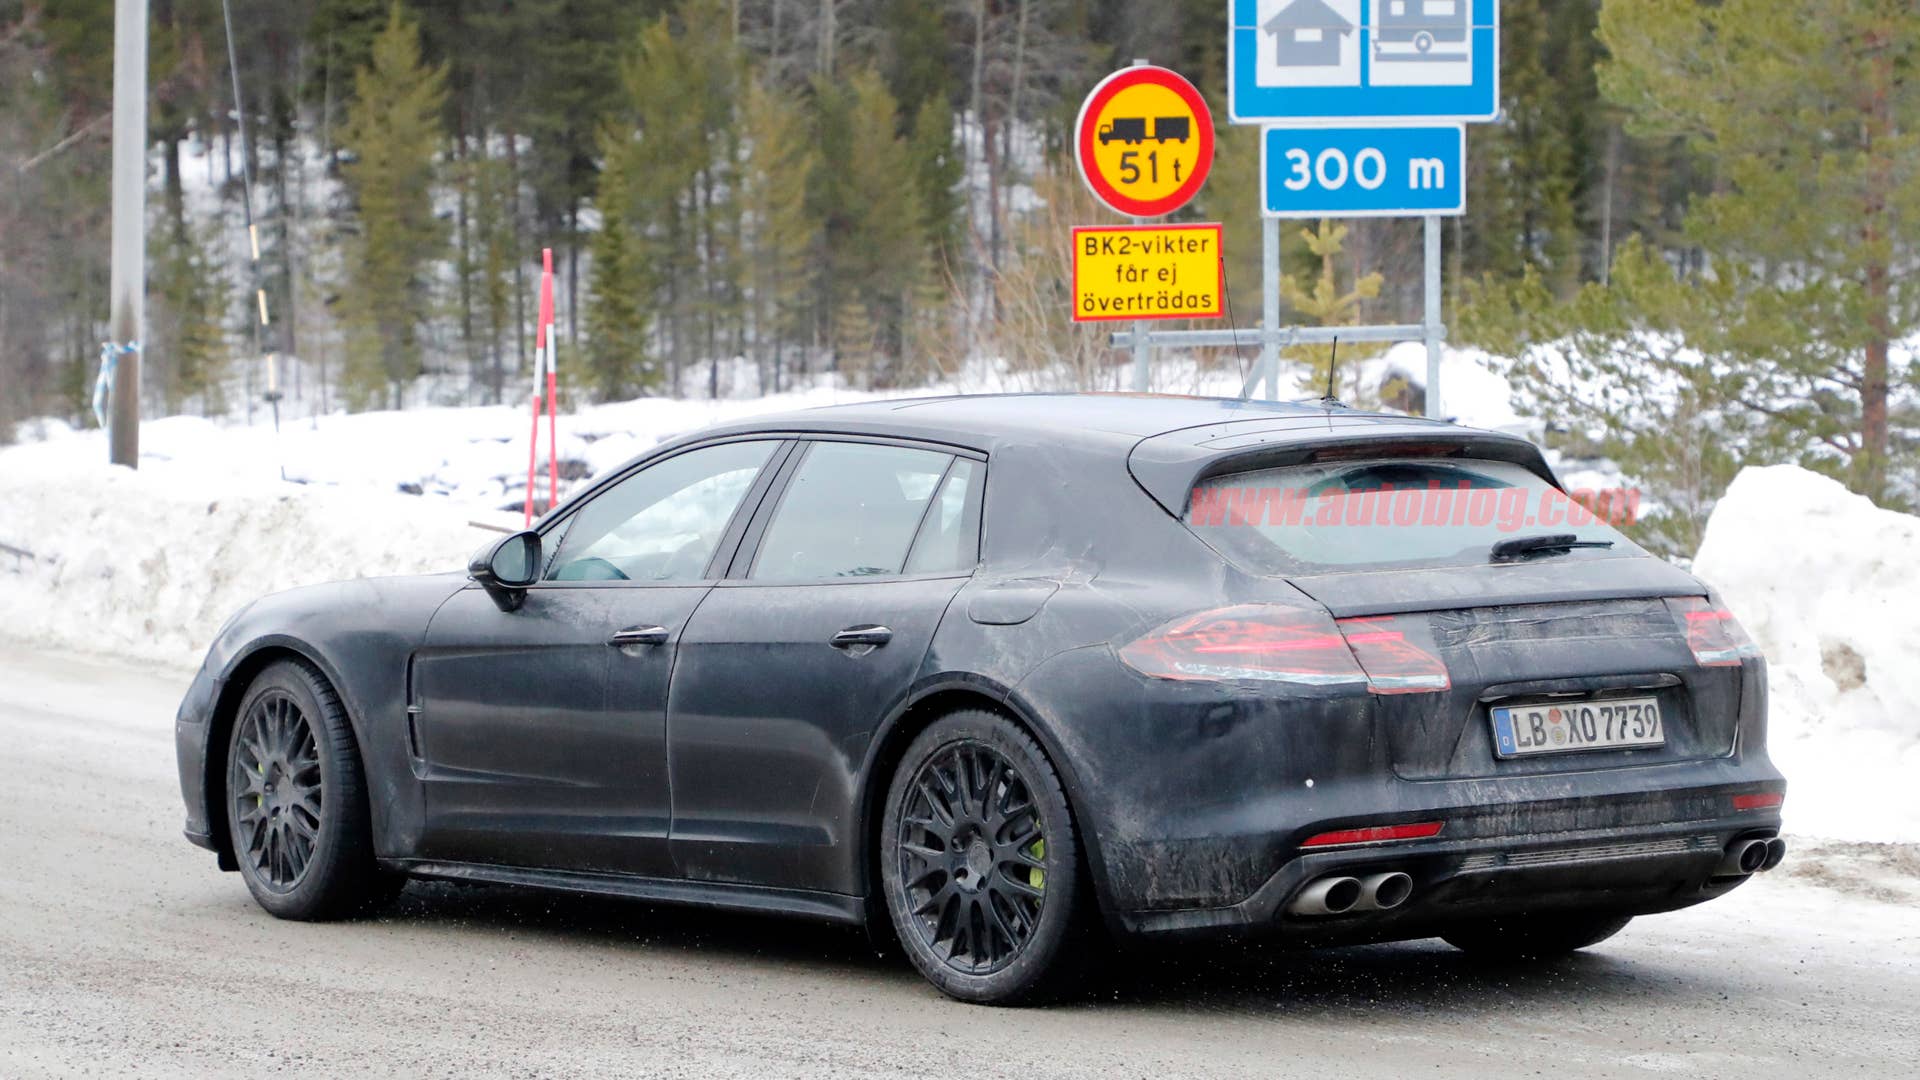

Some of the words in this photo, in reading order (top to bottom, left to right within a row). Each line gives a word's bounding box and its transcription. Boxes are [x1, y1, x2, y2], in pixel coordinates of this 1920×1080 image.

[1119, 150, 1158, 185] 51
[1173, 157, 1181, 182] t
[1283, 147, 1387, 191] 300
[1408, 157, 1445, 190] m
[1085, 235, 1210, 256] BK2-vikter
[1116, 263, 1149, 283] får
[1157, 263, 1177, 286] ej
[1083, 290, 1212, 312] överträdas
[1512, 711, 1548, 748] LB
[1600, 704, 1659, 741] 7739
